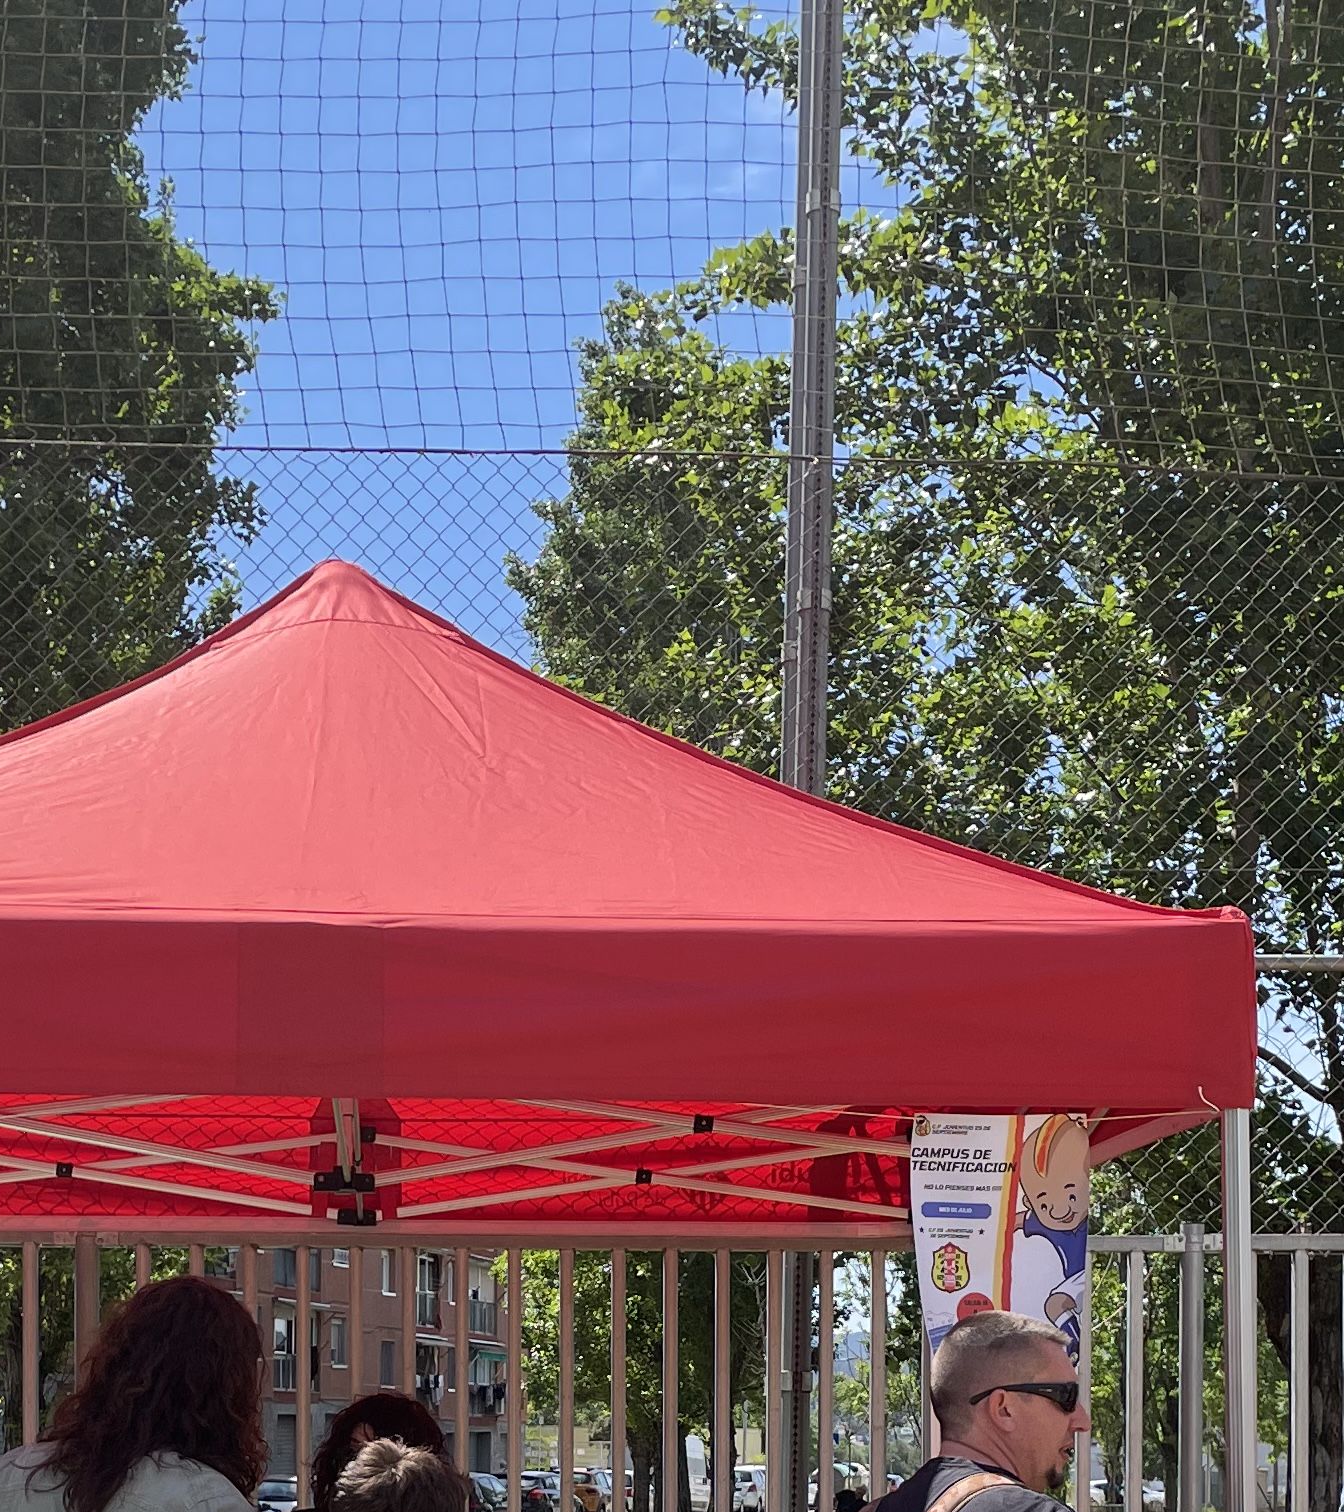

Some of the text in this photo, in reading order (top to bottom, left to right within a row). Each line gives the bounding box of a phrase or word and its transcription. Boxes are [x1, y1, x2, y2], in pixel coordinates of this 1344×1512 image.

[912, 1148, 992, 1160] CAMPUS DE
[912, 1160, 1016, 1173] TECNIFICACION
